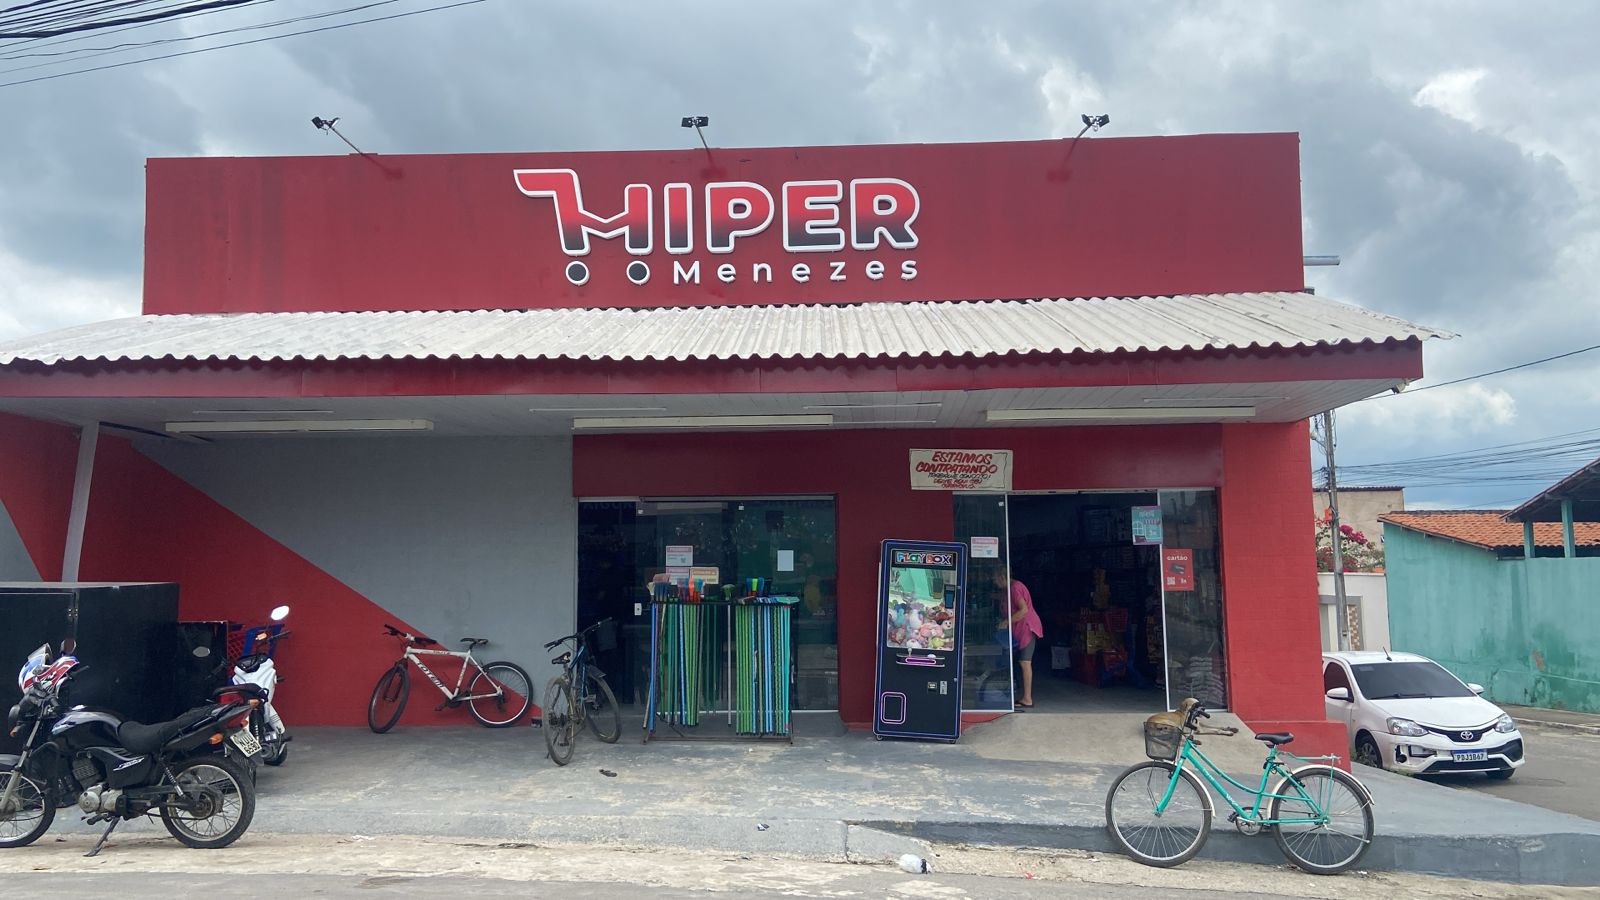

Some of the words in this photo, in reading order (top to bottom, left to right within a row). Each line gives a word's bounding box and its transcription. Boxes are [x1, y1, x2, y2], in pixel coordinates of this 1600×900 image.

[513, 168, 920, 256] HIPER
[672, 258, 918, 284] Menezes
[932, 451, 993, 465] ESTAMOS
[915, 461, 998, 474] CONTRATANDO
[926, 553, 951, 565] BOX
